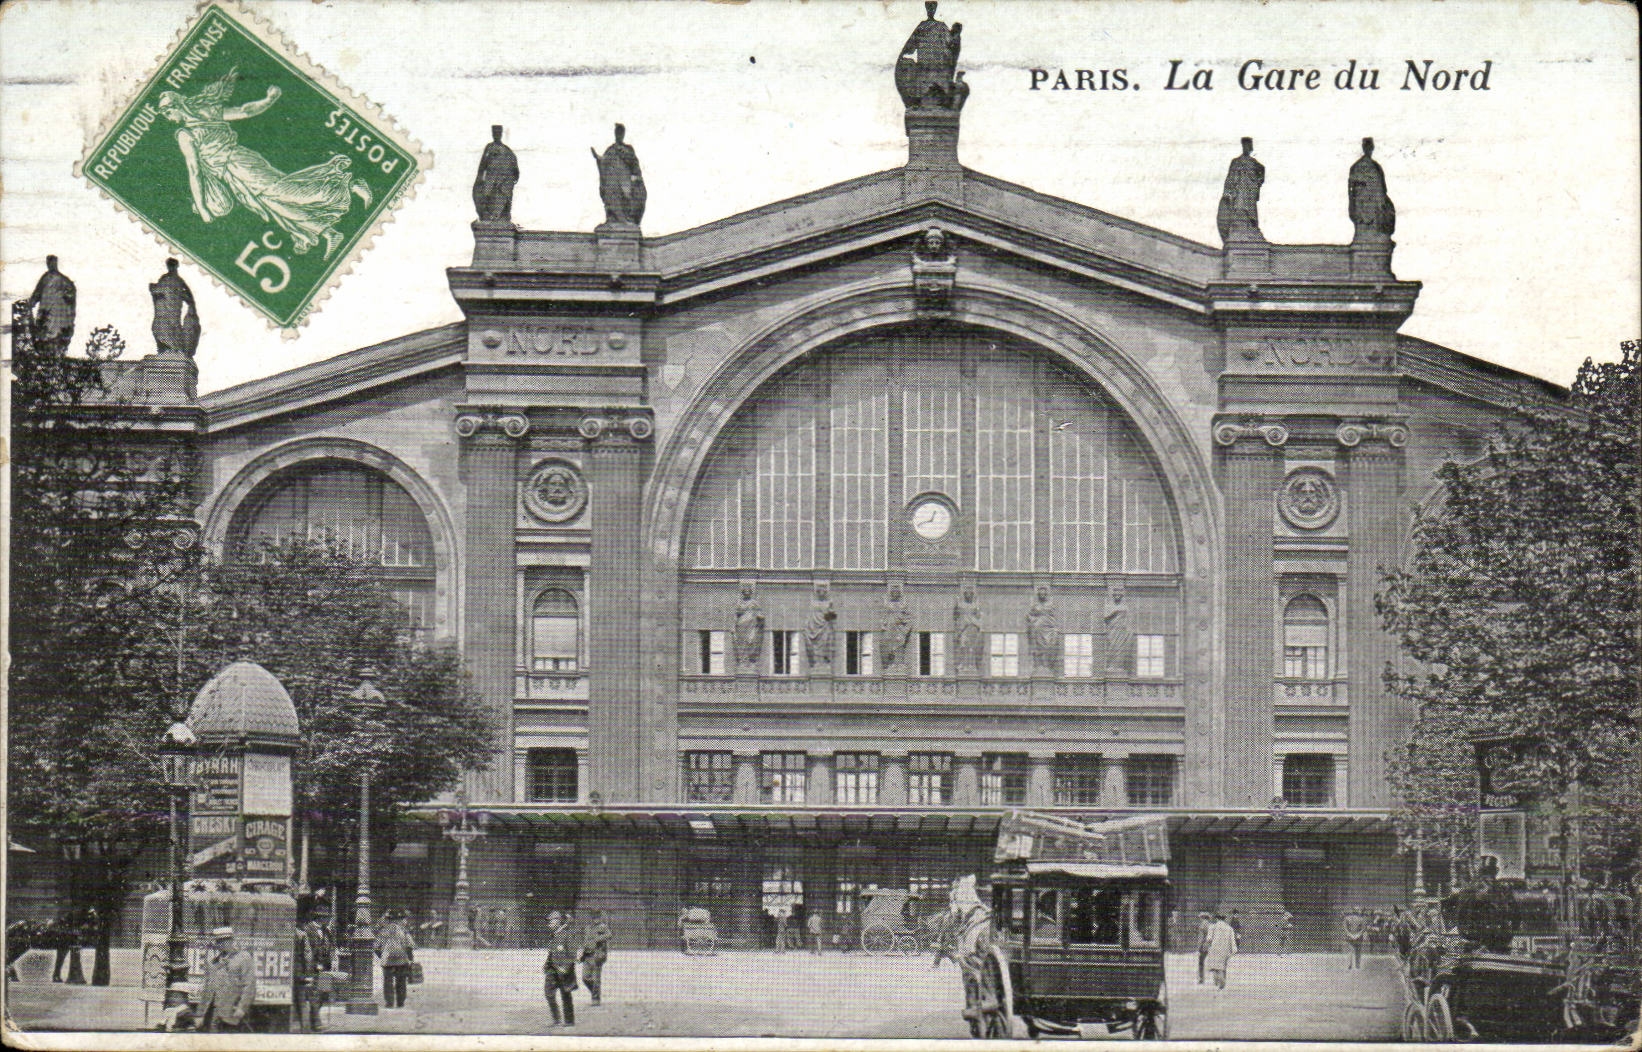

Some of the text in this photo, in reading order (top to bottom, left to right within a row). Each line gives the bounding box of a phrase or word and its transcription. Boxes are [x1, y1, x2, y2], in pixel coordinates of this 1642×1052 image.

[325, 108, 399, 174] POSTES
[506, 324, 601, 356] NORD
[1263, 335, 1357, 368] NORD
[245, 820, 286, 841] CIRAGE
